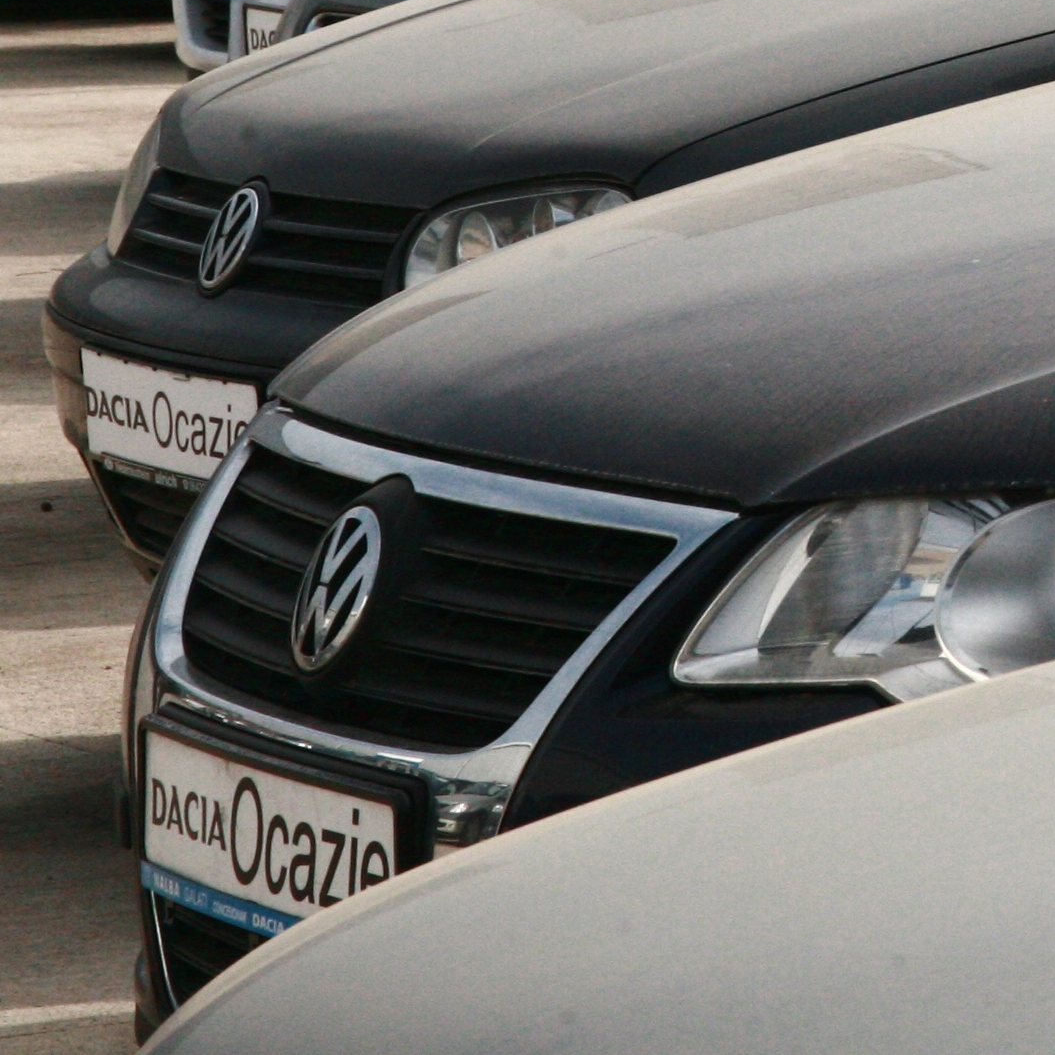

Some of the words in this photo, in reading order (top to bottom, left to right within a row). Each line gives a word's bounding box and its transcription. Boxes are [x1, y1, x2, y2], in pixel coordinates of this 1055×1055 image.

[86, 386, 150, 434] DACIA
[151, 778, 227, 852] DACIA
[230, 776, 390, 908] Ocazie
